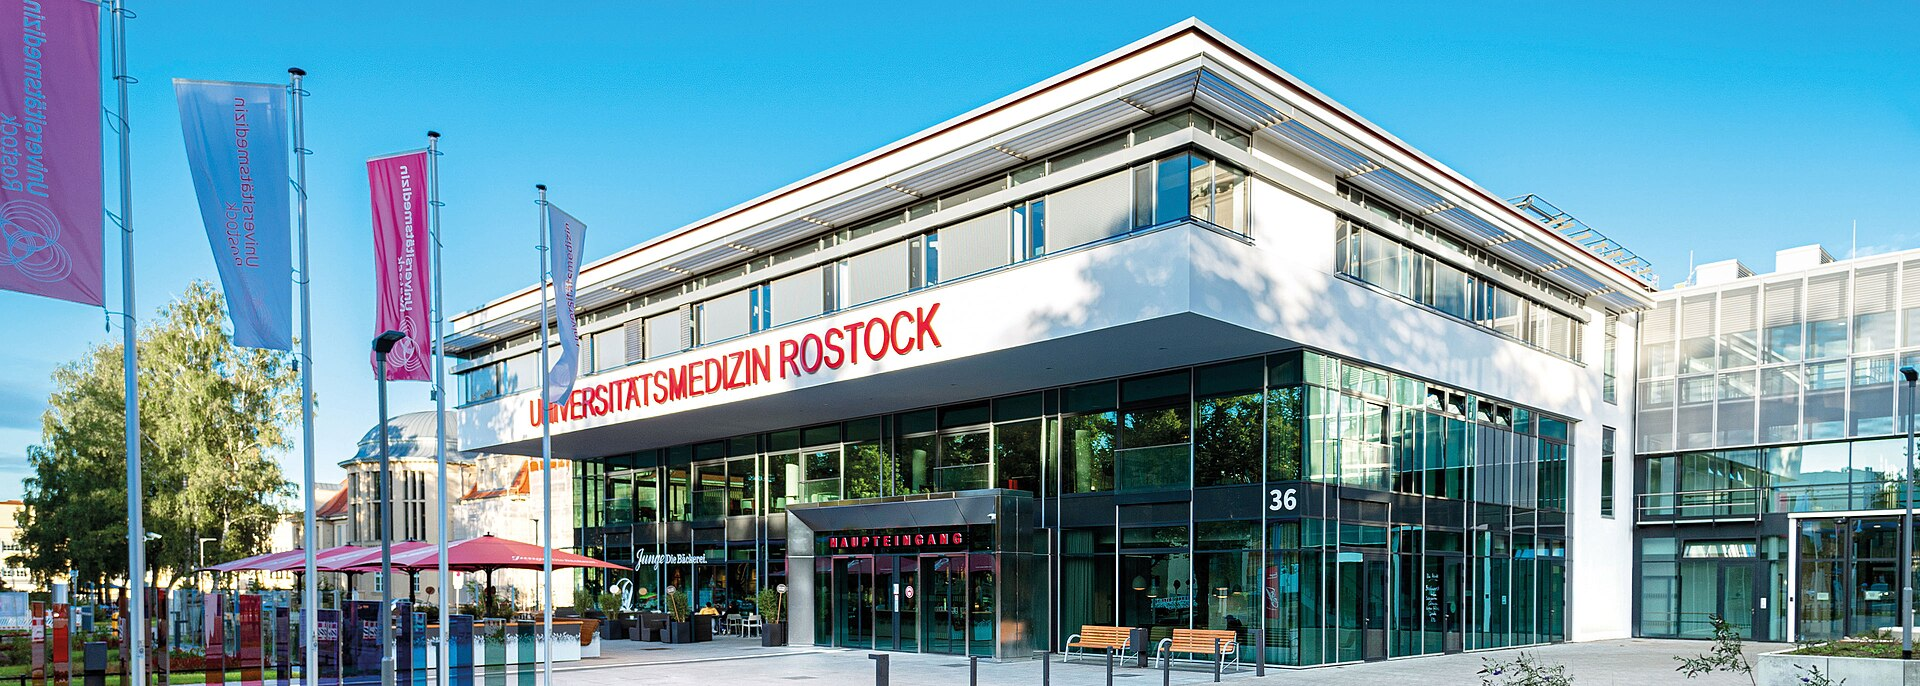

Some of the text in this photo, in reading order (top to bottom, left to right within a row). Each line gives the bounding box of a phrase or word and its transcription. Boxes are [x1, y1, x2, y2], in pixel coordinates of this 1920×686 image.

[780, 303, 942, 379] ROSTOCK
[1269, 488, 1297, 511] 36
[829, 532, 963, 548] HAUPTEINGANG
[635, 548, 665, 571] Junge
[666, 553, 677, 564] Die
